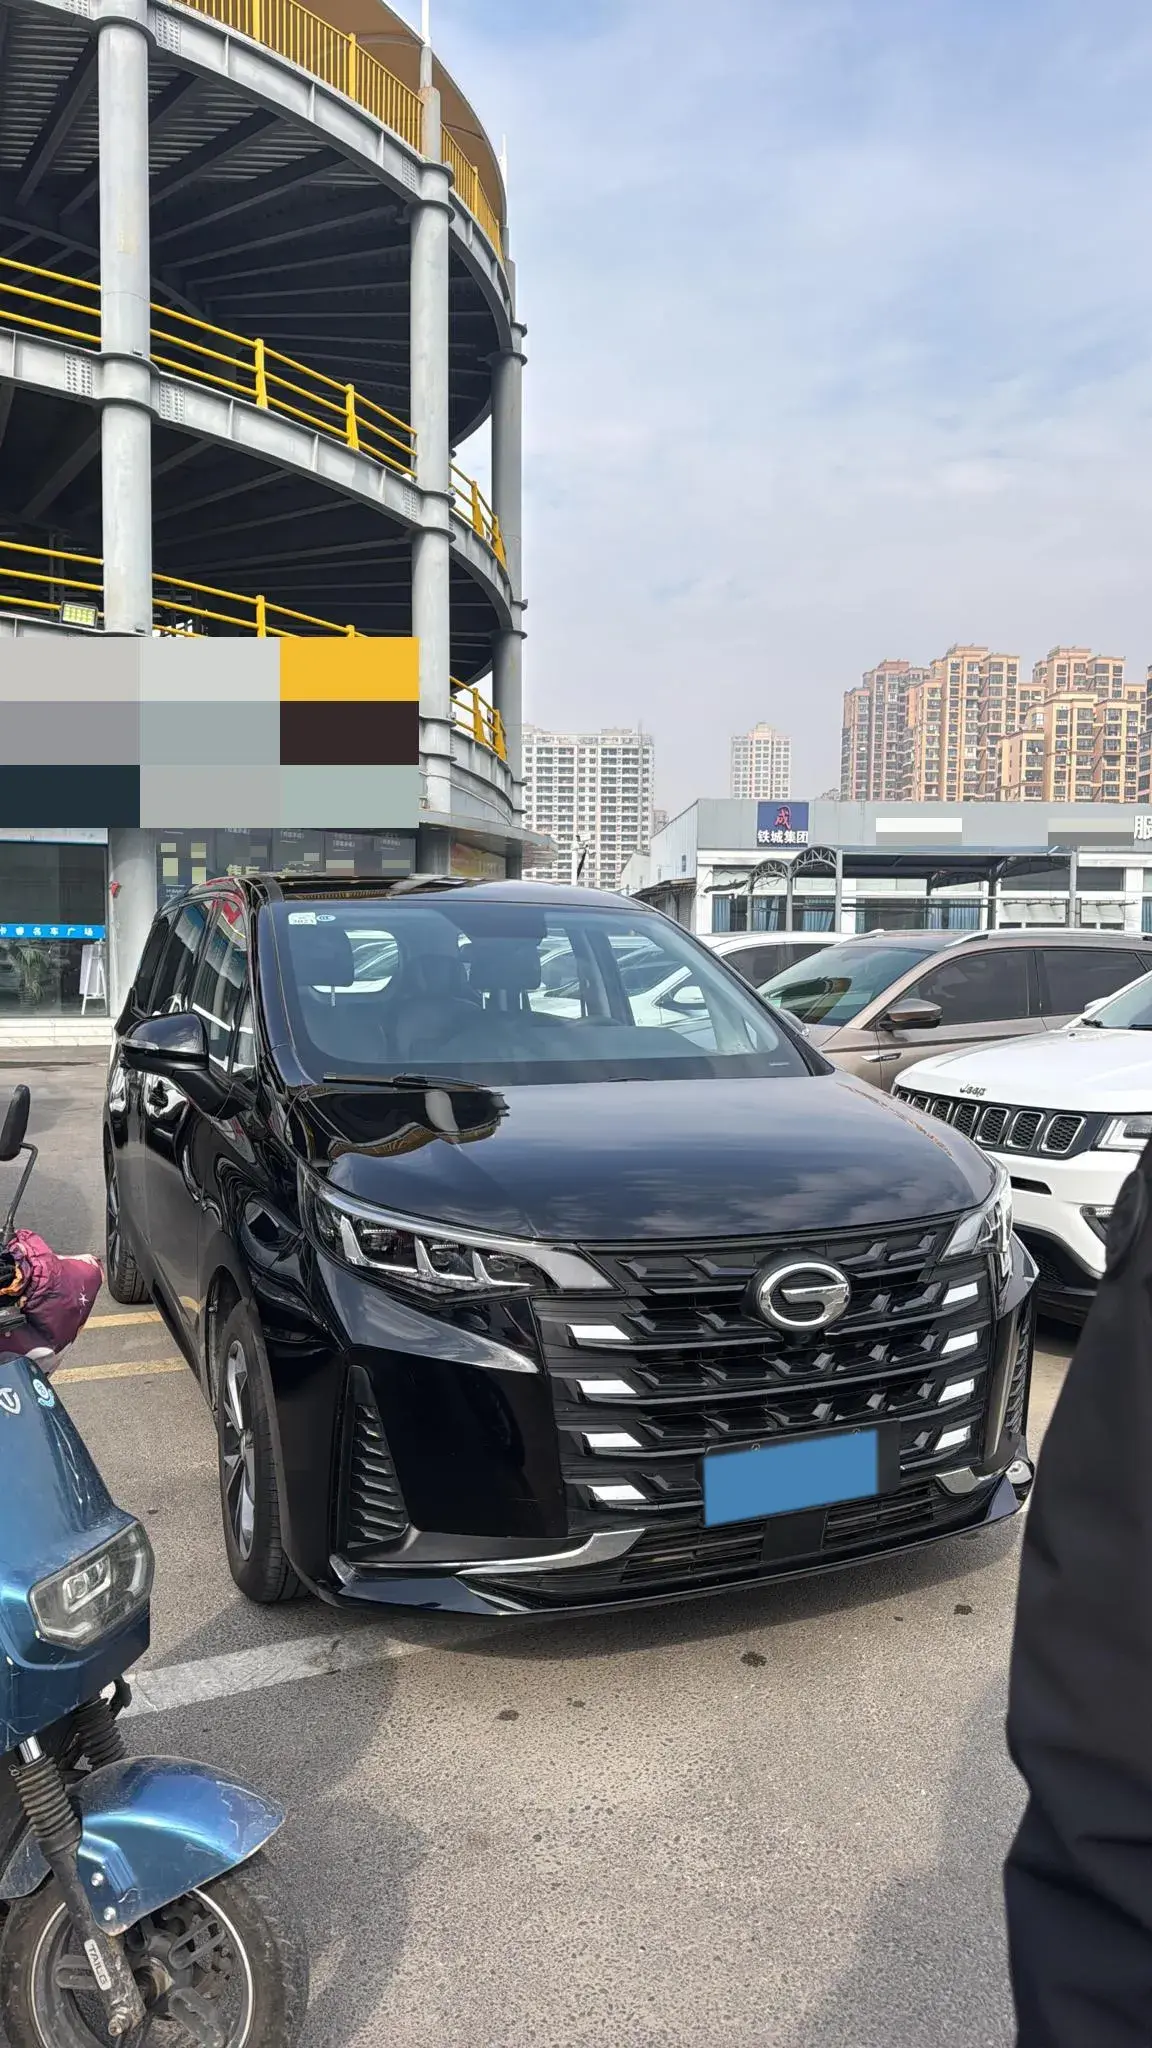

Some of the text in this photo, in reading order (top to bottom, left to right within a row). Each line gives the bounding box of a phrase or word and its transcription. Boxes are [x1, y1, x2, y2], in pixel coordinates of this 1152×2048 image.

[757, 829, 808, 844] 铁城集团
[960, 1083, 986, 1098] Jeep
[88, 1943, 108, 1985] TAILG
